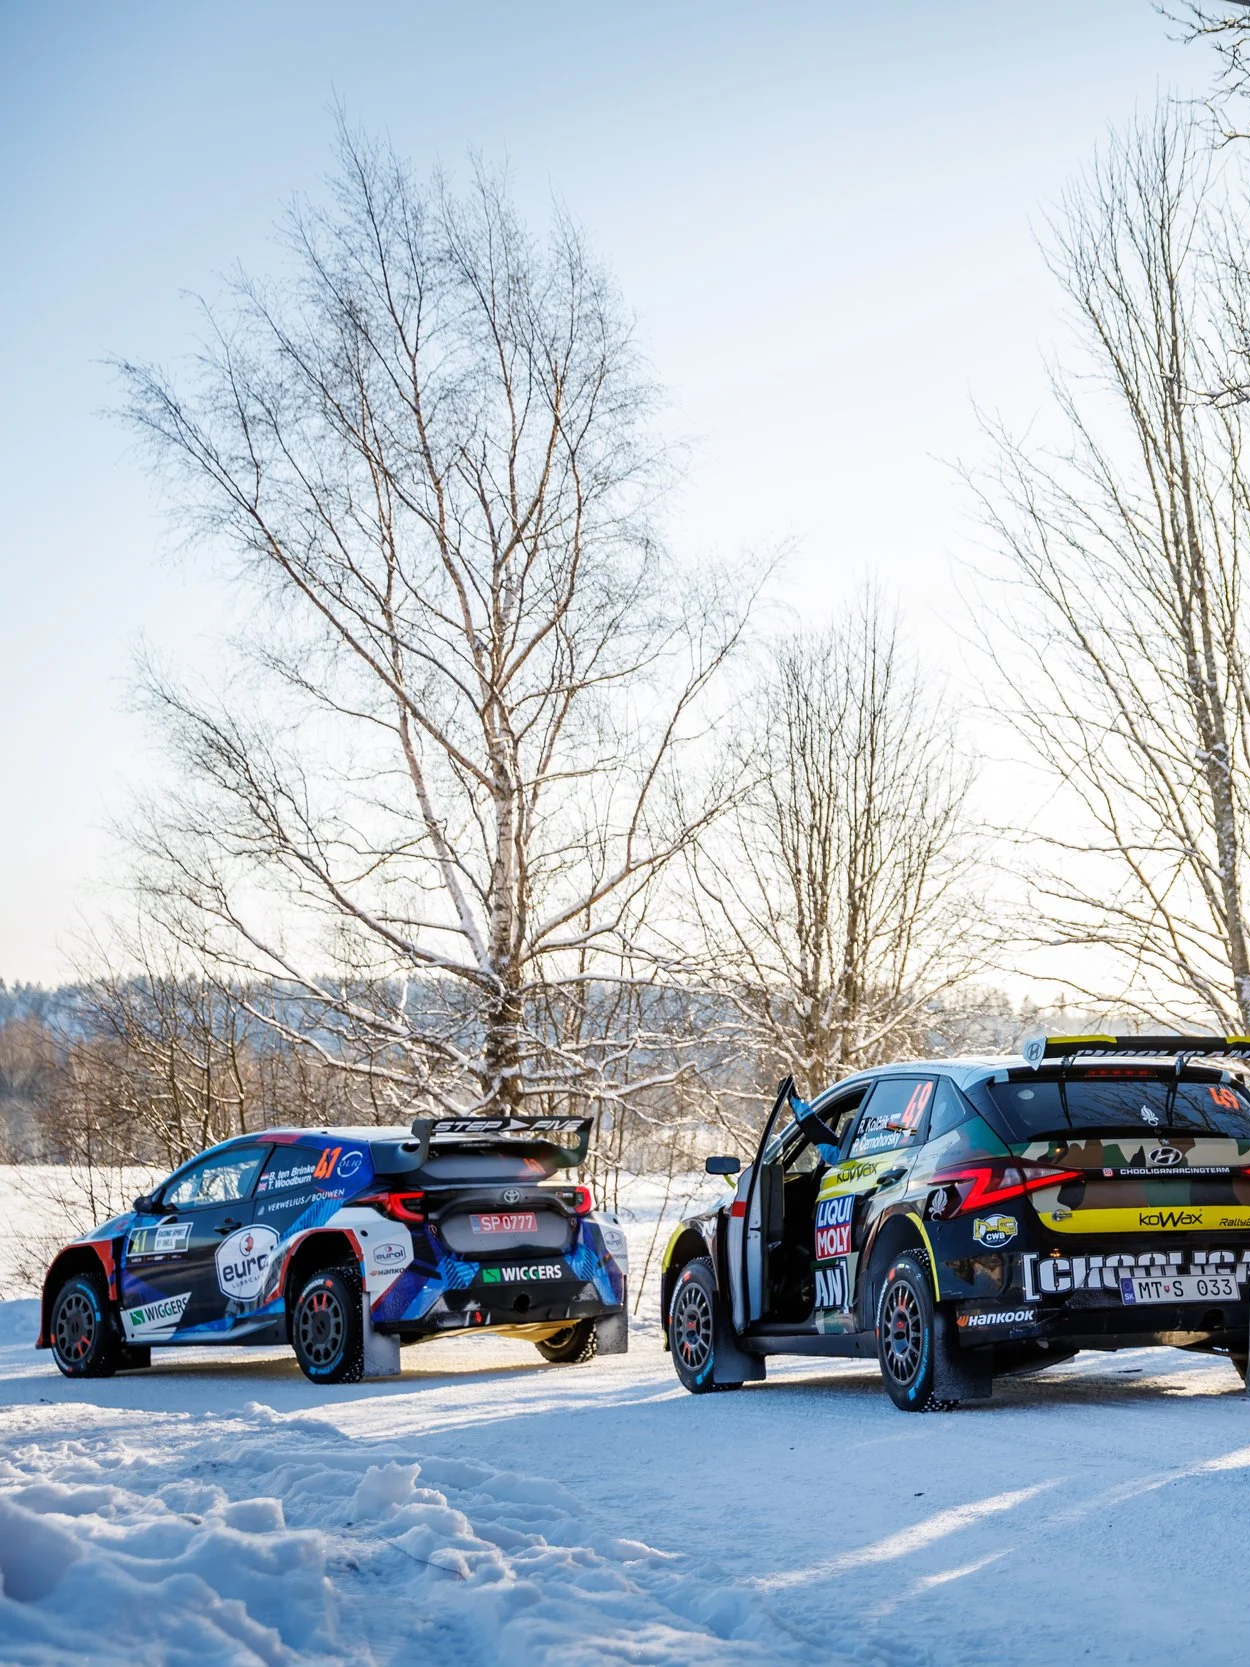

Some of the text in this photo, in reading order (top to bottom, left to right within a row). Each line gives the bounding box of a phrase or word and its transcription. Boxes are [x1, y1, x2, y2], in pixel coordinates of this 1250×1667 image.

[901, 1081, 933, 1128] 49
[1208, 1087, 1240, 1111] 49
[432, 1119, 585, 1132] STEP FIVE
[313, 1147, 343, 1180] 41
[275, 1174, 312, 1189] Woodburn
[818, 1196, 853, 1227] LIQUI
[481, 1215, 533, 1231] SP 0777
[817, 1226, 851, 1257] MOLY
[986, 1232, 1006, 1241] CWB
[376, 1250, 404, 1260] eurol
[502, 1264, 562, 1281] WIGGERS
[1125, 1293, 1135, 1301] SK
[1138, 1281, 1162, 1299] MT
[1196, 1279, 1233, 1296] 033
[144, 1296, 189, 1322] WIGGERS
